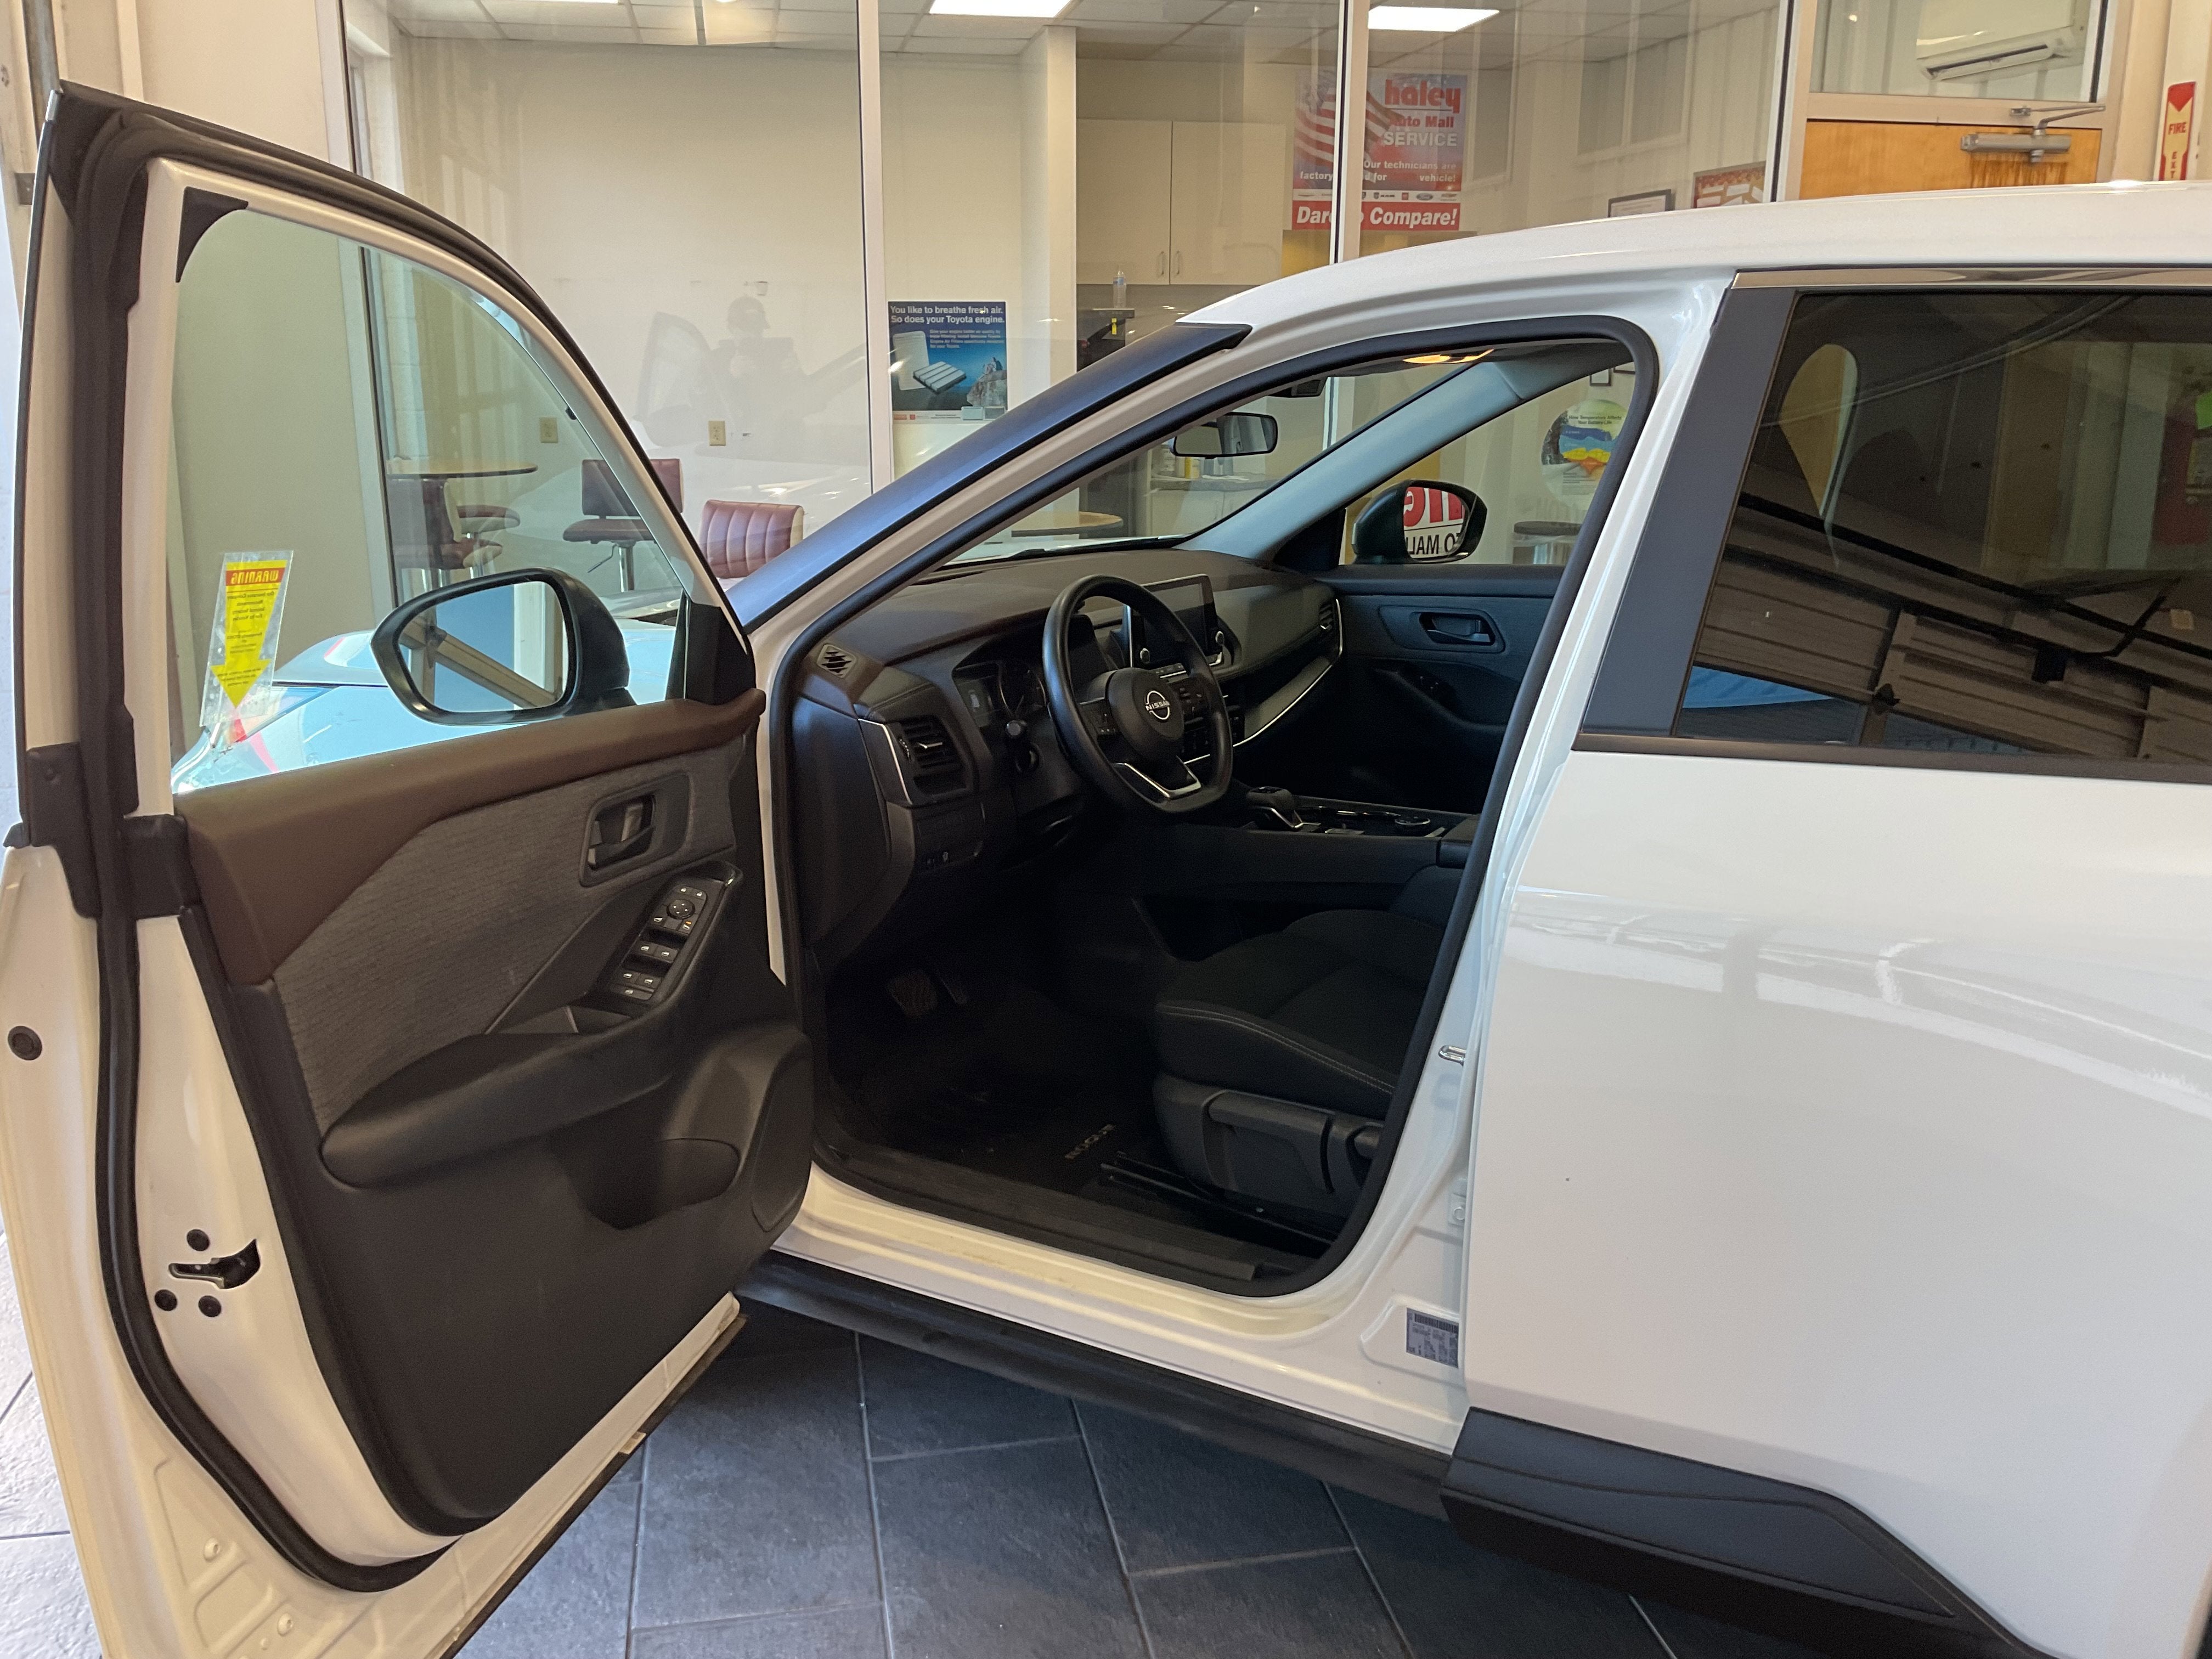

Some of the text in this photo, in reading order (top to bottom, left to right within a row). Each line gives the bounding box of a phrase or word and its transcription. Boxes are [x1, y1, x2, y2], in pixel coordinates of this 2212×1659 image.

[1385, 79, 1461, 114] haley
[1425, 116, 1454, 128] Mall
[2168, 122, 2187, 134] FIRE
[1383, 131, 1458, 146] SERVICE
[1364, 161, 1381, 169] Our
[1384, 160, 1438, 170] technicians
[1374, 172, 1387, 181] for
[1419, 173, 1456, 183] vehicle!
[1369, 207, 1458, 229] Compare!
[946, 315, 973, 324] Toyota
[975, 315, 1005, 324] engine.
[1146, 701, 1170, 711] NISSAN
